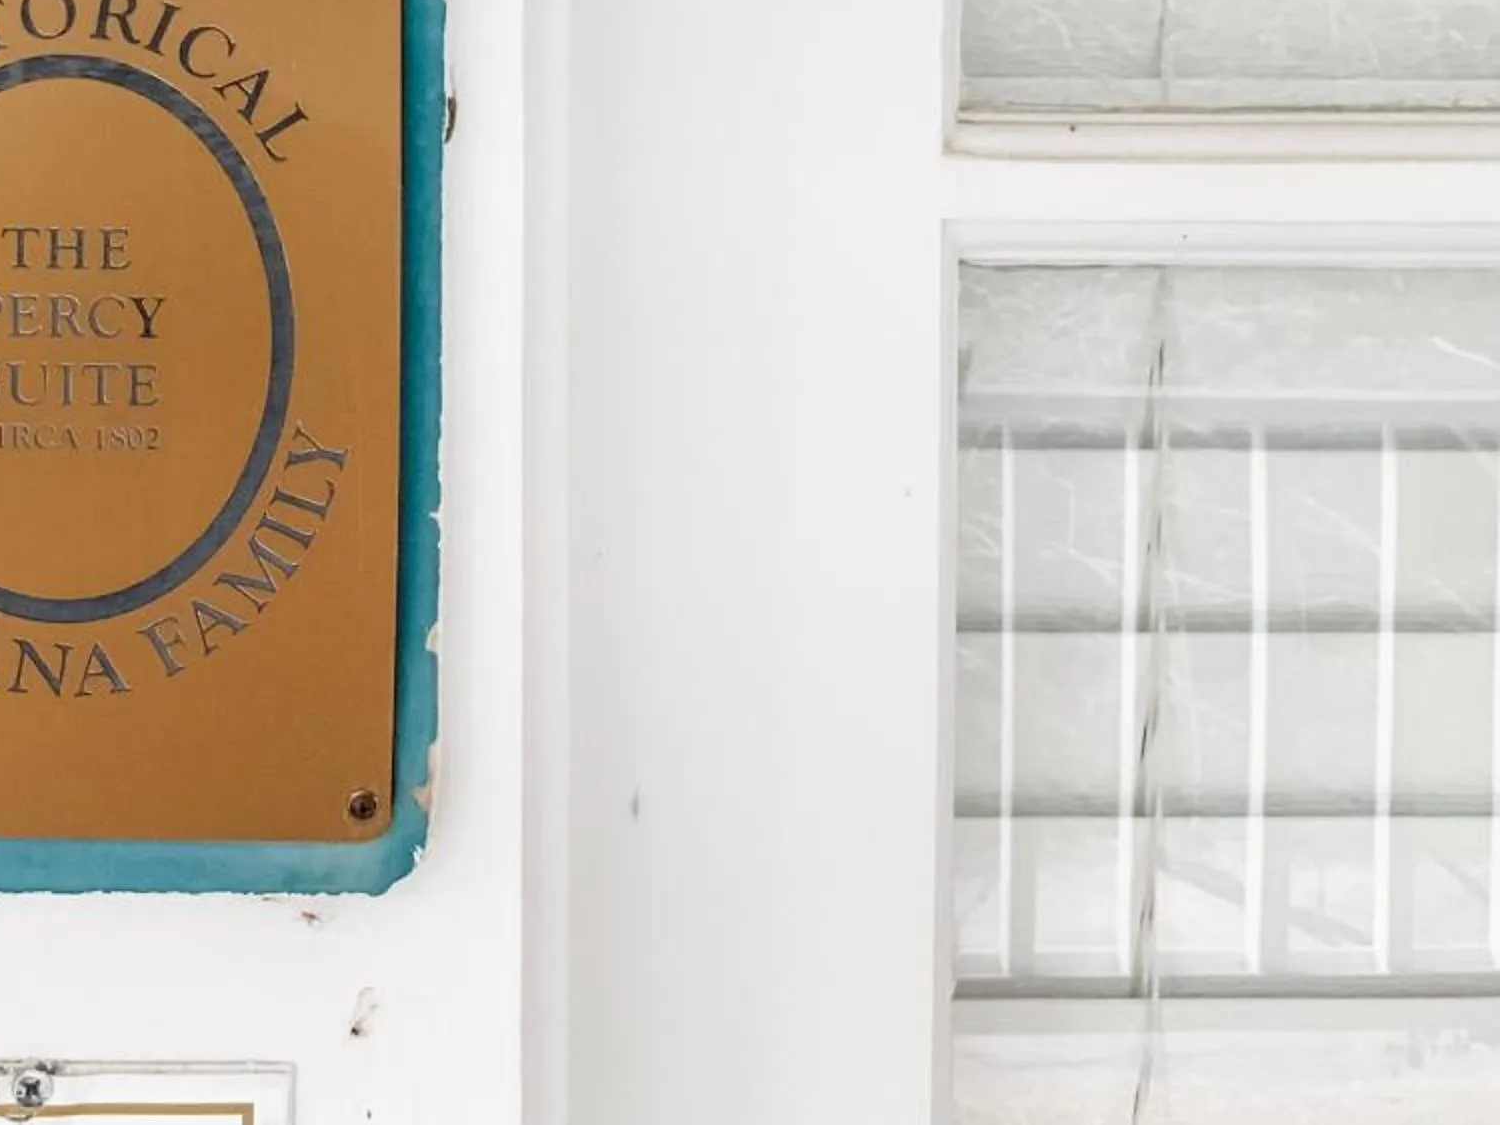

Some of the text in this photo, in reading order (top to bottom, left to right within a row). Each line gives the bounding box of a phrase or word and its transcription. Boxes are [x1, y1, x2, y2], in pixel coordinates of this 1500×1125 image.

[1, 225, 132, 270] THE
[96, 426, 161, 451] 1802
[138, 422, 349, 678] FAMILY
